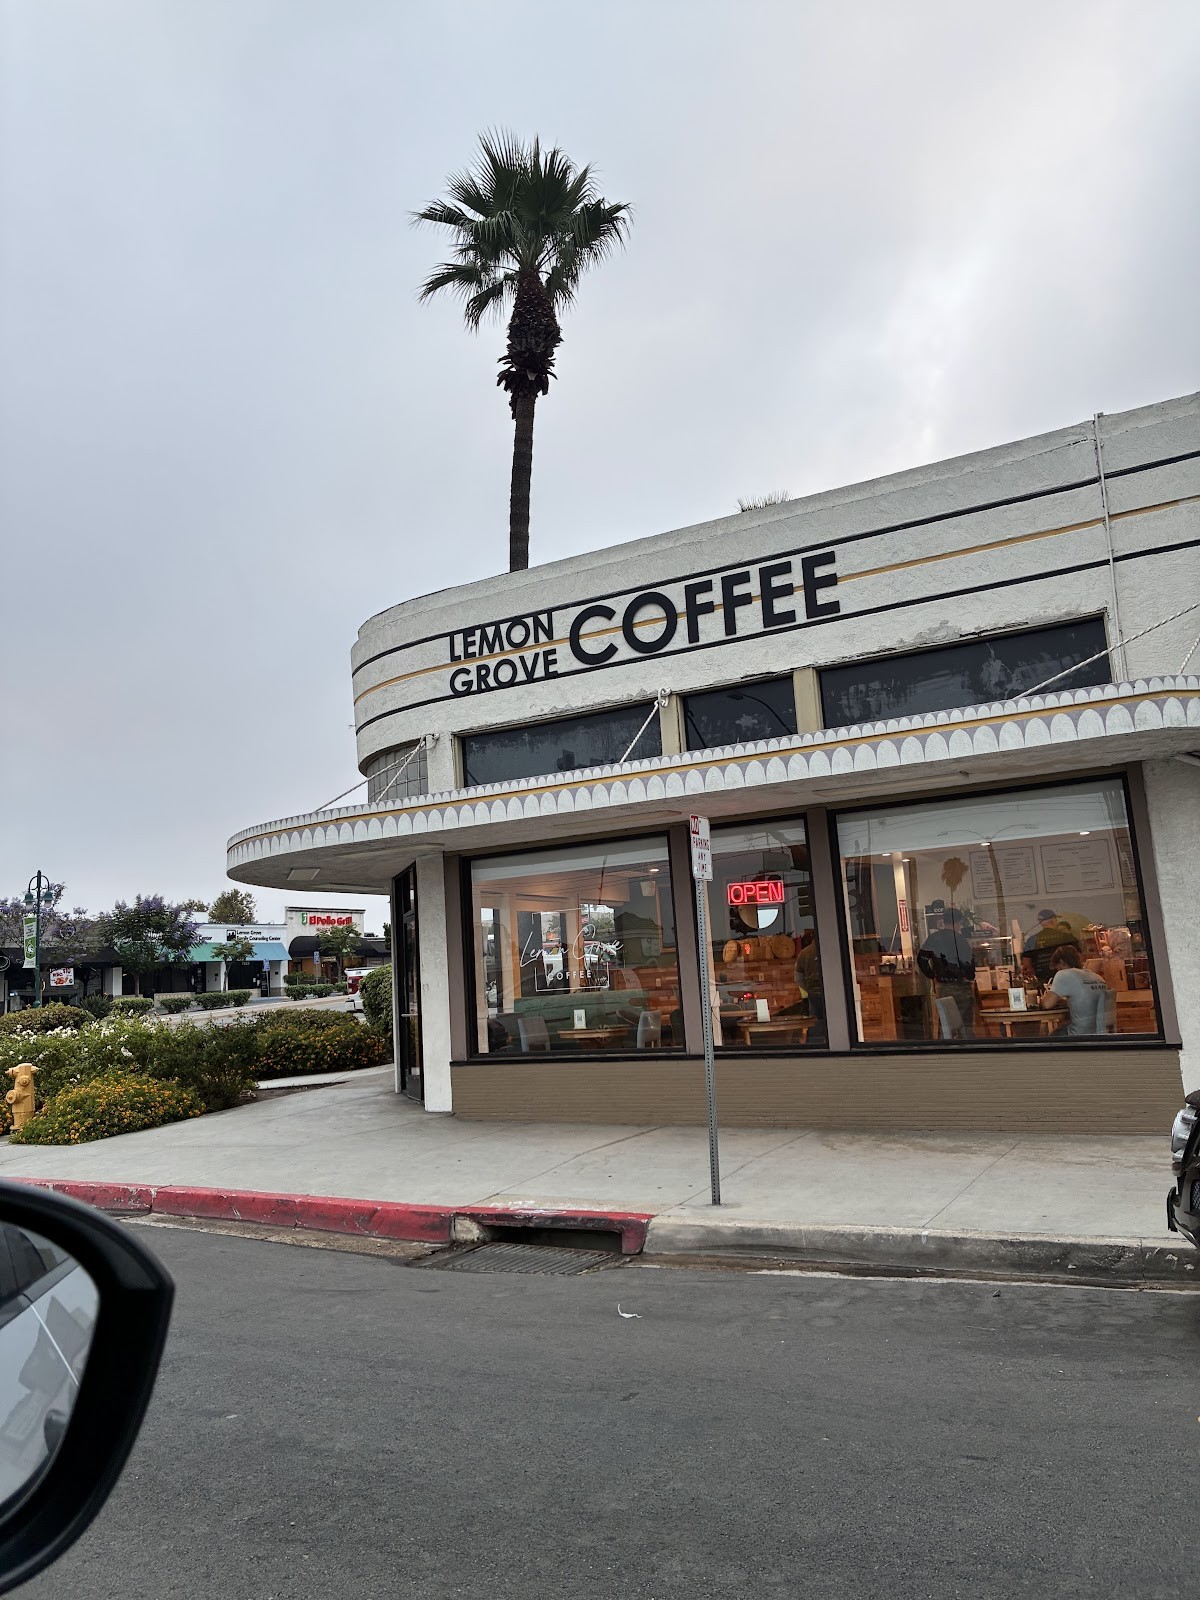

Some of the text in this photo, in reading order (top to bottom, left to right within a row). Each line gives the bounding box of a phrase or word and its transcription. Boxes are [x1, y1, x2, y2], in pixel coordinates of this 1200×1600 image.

[569, 551, 841, 666] COFFEE
[449, 610, 554, 662] LEMON
[449, 648, 559, 697] GROVE
[730, 882, 782, 903] OPEN
[309, 915, 352, 926] El Pollo Grill
[547, 970, 592, 981] COFFEE
